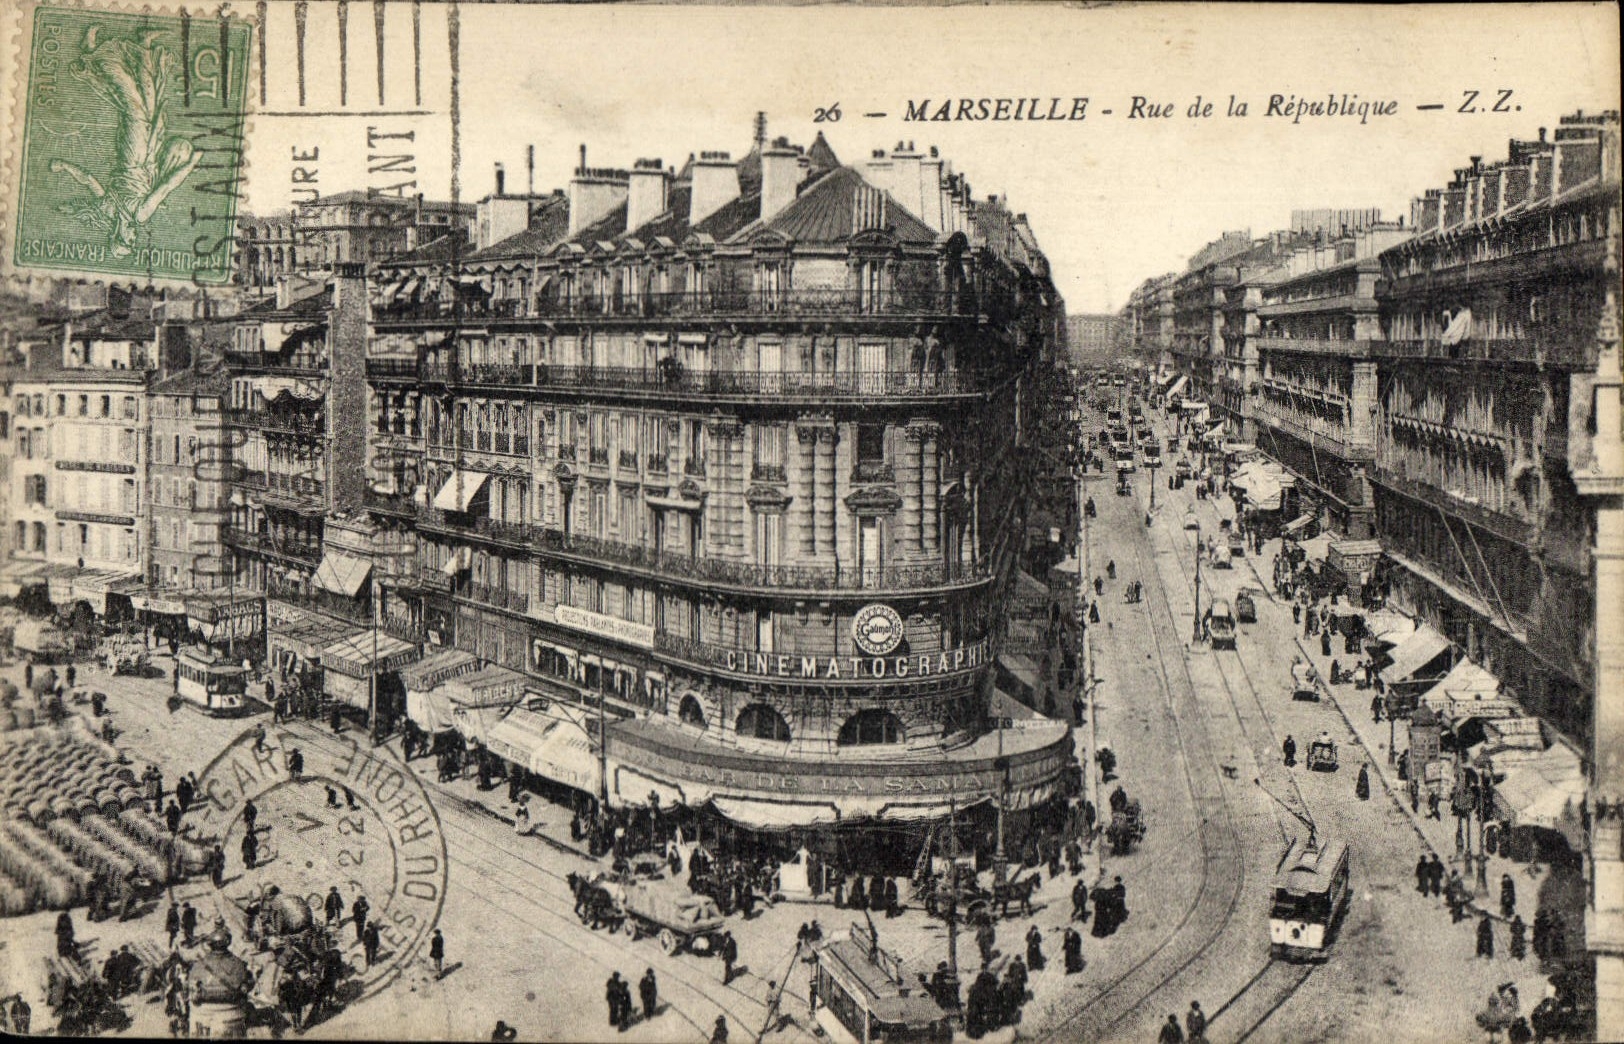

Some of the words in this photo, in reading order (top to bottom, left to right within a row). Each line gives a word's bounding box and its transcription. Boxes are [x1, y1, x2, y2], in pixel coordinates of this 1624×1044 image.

[37, 23, 62, 108] POSTES
[756, 775, 799, 790] DE
[821, 778, 863, 792] LA
